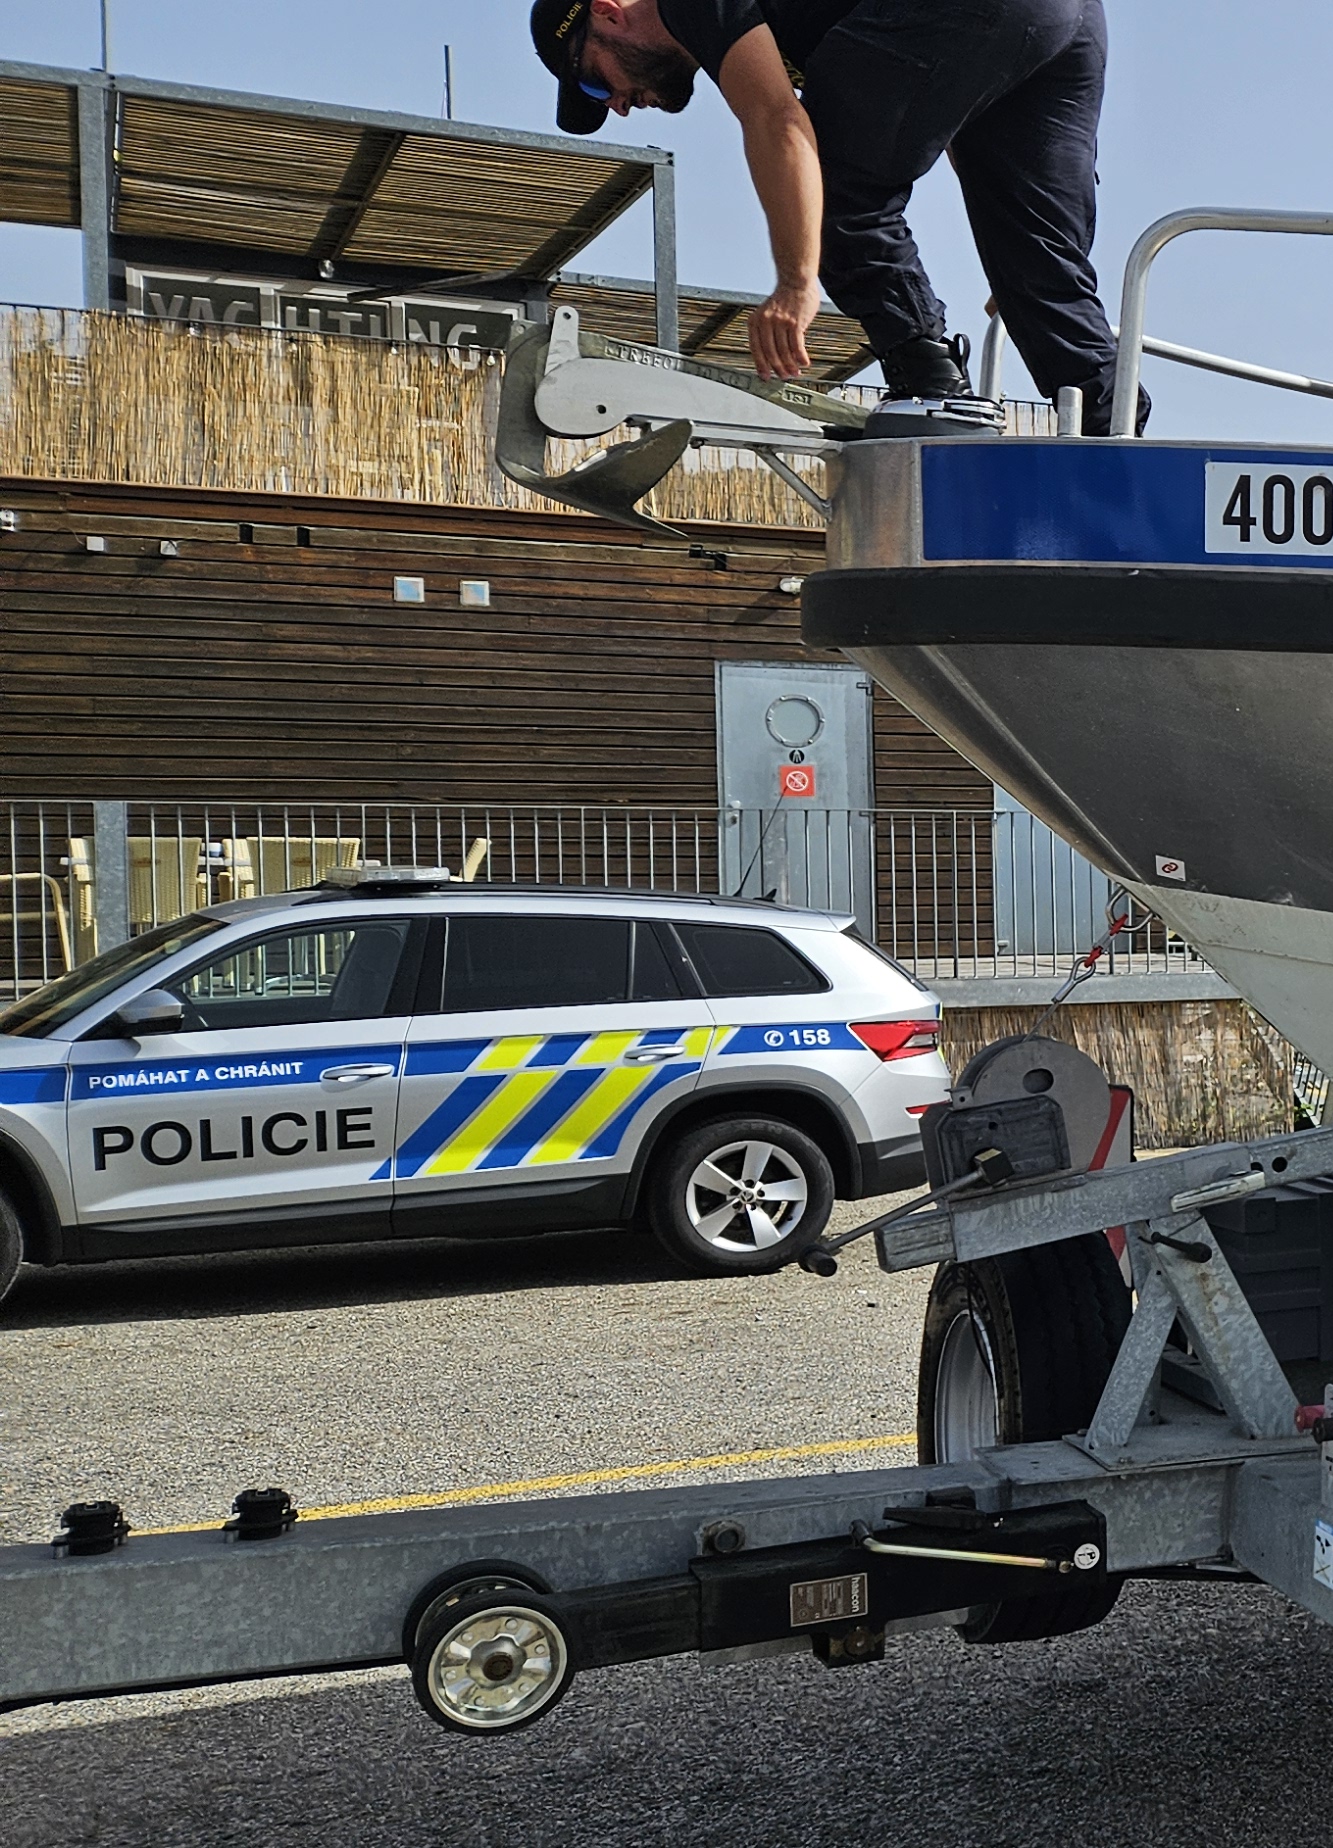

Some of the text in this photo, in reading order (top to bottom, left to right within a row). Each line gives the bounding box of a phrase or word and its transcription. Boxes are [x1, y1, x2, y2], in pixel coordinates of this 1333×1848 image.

[555, 0, 583, 39] POLICIE
[788, 1028, 831, 1046] 158
[88, 1060, 304, 1090] POMÁHAT A CHRÁNIT
[92, 1106, 376, 1172] POLICIE
